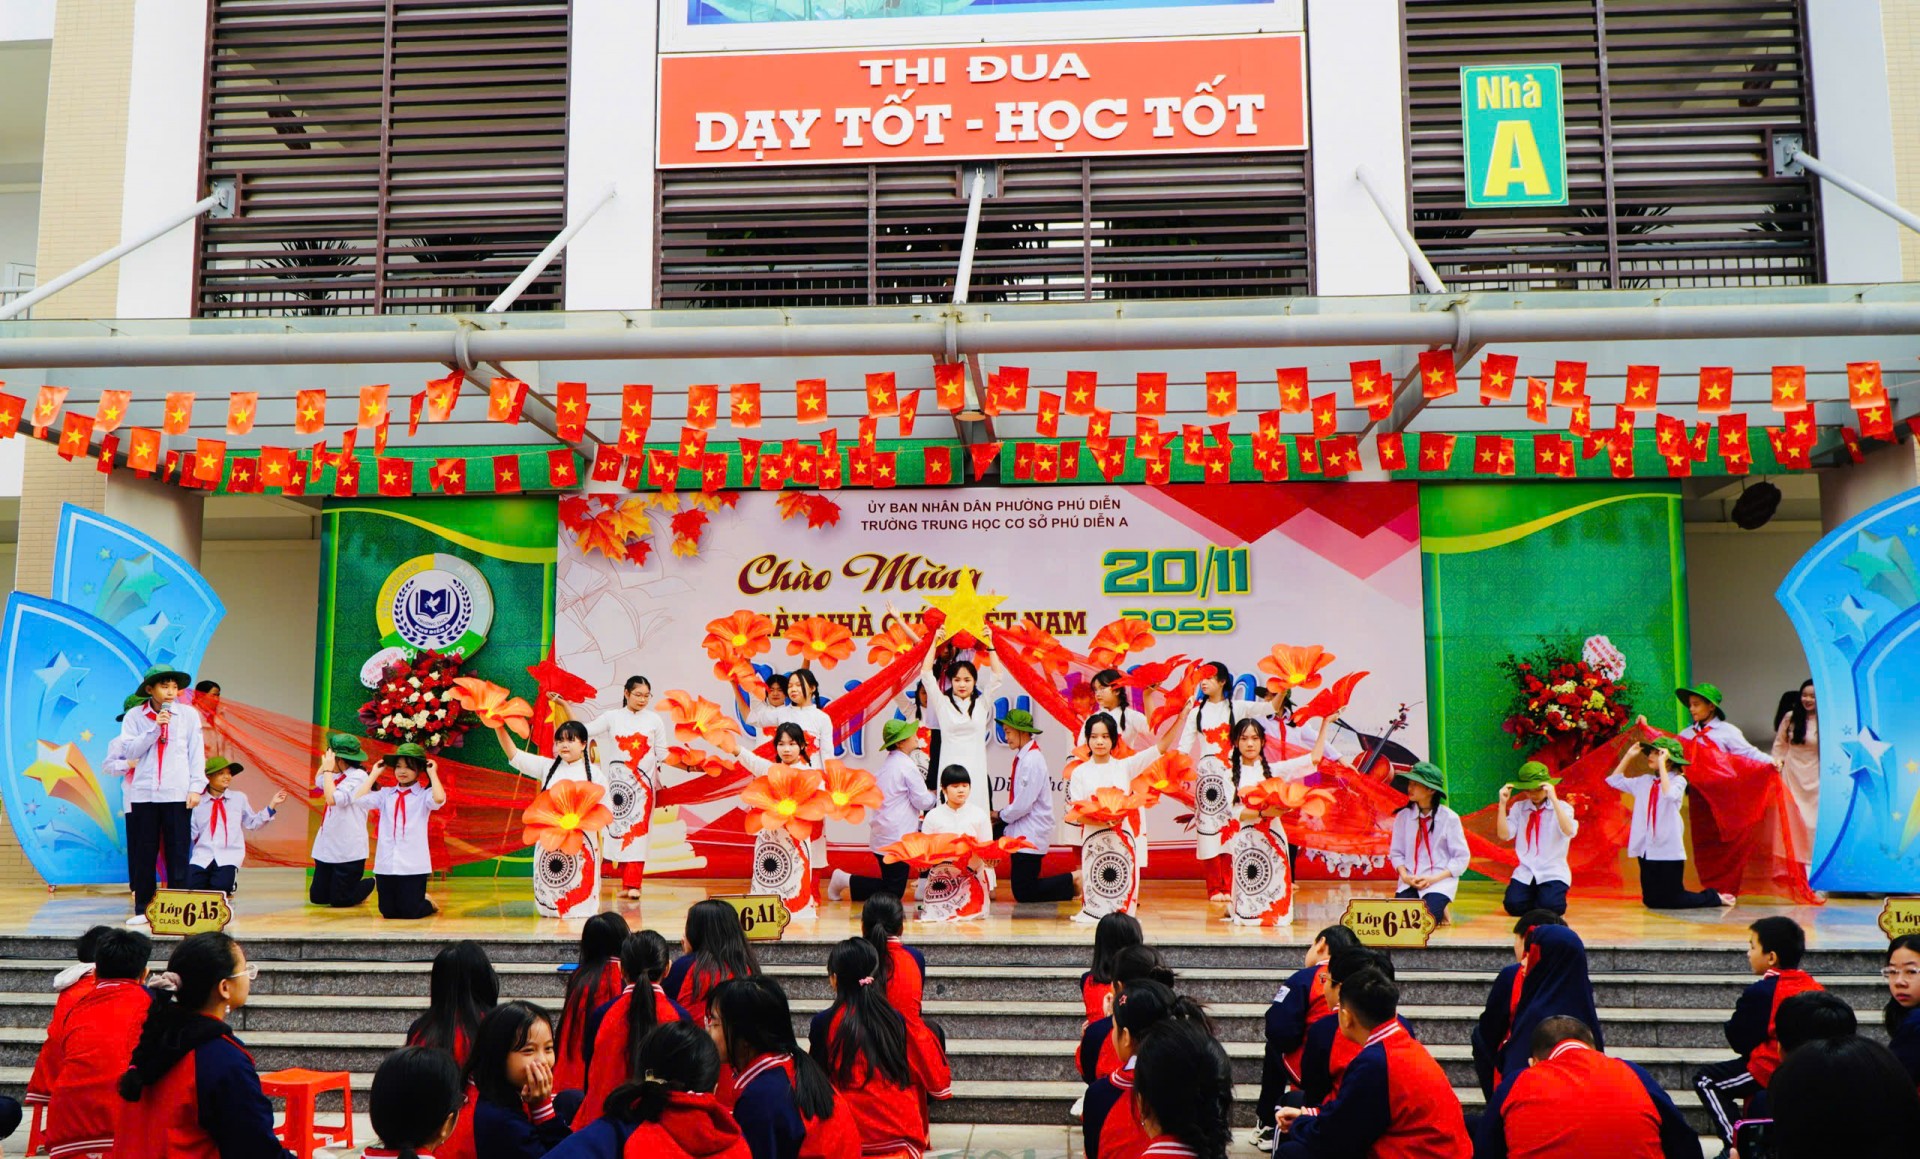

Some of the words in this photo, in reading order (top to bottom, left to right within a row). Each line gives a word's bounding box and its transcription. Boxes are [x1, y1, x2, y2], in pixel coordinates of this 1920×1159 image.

[860, 57, 947, 87] THI
[966, 52, 1091, 83] ĐUA
[1477, 73, 1542, 110] Nhà
[695, 108, 822, 160] DẠY
[835, 89, 952, 147] TỐT
[995, 98, 1128, 152] HỌC
[1143, 74, 1266, 138] TỐT
[1483, 120, 1552, 197] A
[868, 500, 886, 514] ỦY
[890, 503, 918, 513] BAN
[922, 500, 959, 513] NHÂN
[963, 500, 991, 512] DÂN
[996, 498, 1053, 511] PHƯỜNG
[1057, 498, 1085, 511] PHÚ
[1089, 495, 1121, 510] DIỄN
[861, 517, 918, 531] TRƯỜNG
[921, 519, 968, 530] TRUNG
[972, 519, 1001, 532] HỌC
[1005, 518, 1025, 529] CƠ
[1028, 514, 1048, 529] SỞ
[1052, 515, 1079, 528] PHÚ
[1083, 513, 1115, 528] DIỄN
[1118, 517, 1129, 527] A
[738, 554, 832, 595] Chào
[1102, 545, 1250, 600] 20/11
[817, 606, 873, 637] HÀ
[159, 902, 182, 917] Lớp
[1356, 912, 1382, 928] Lớp
